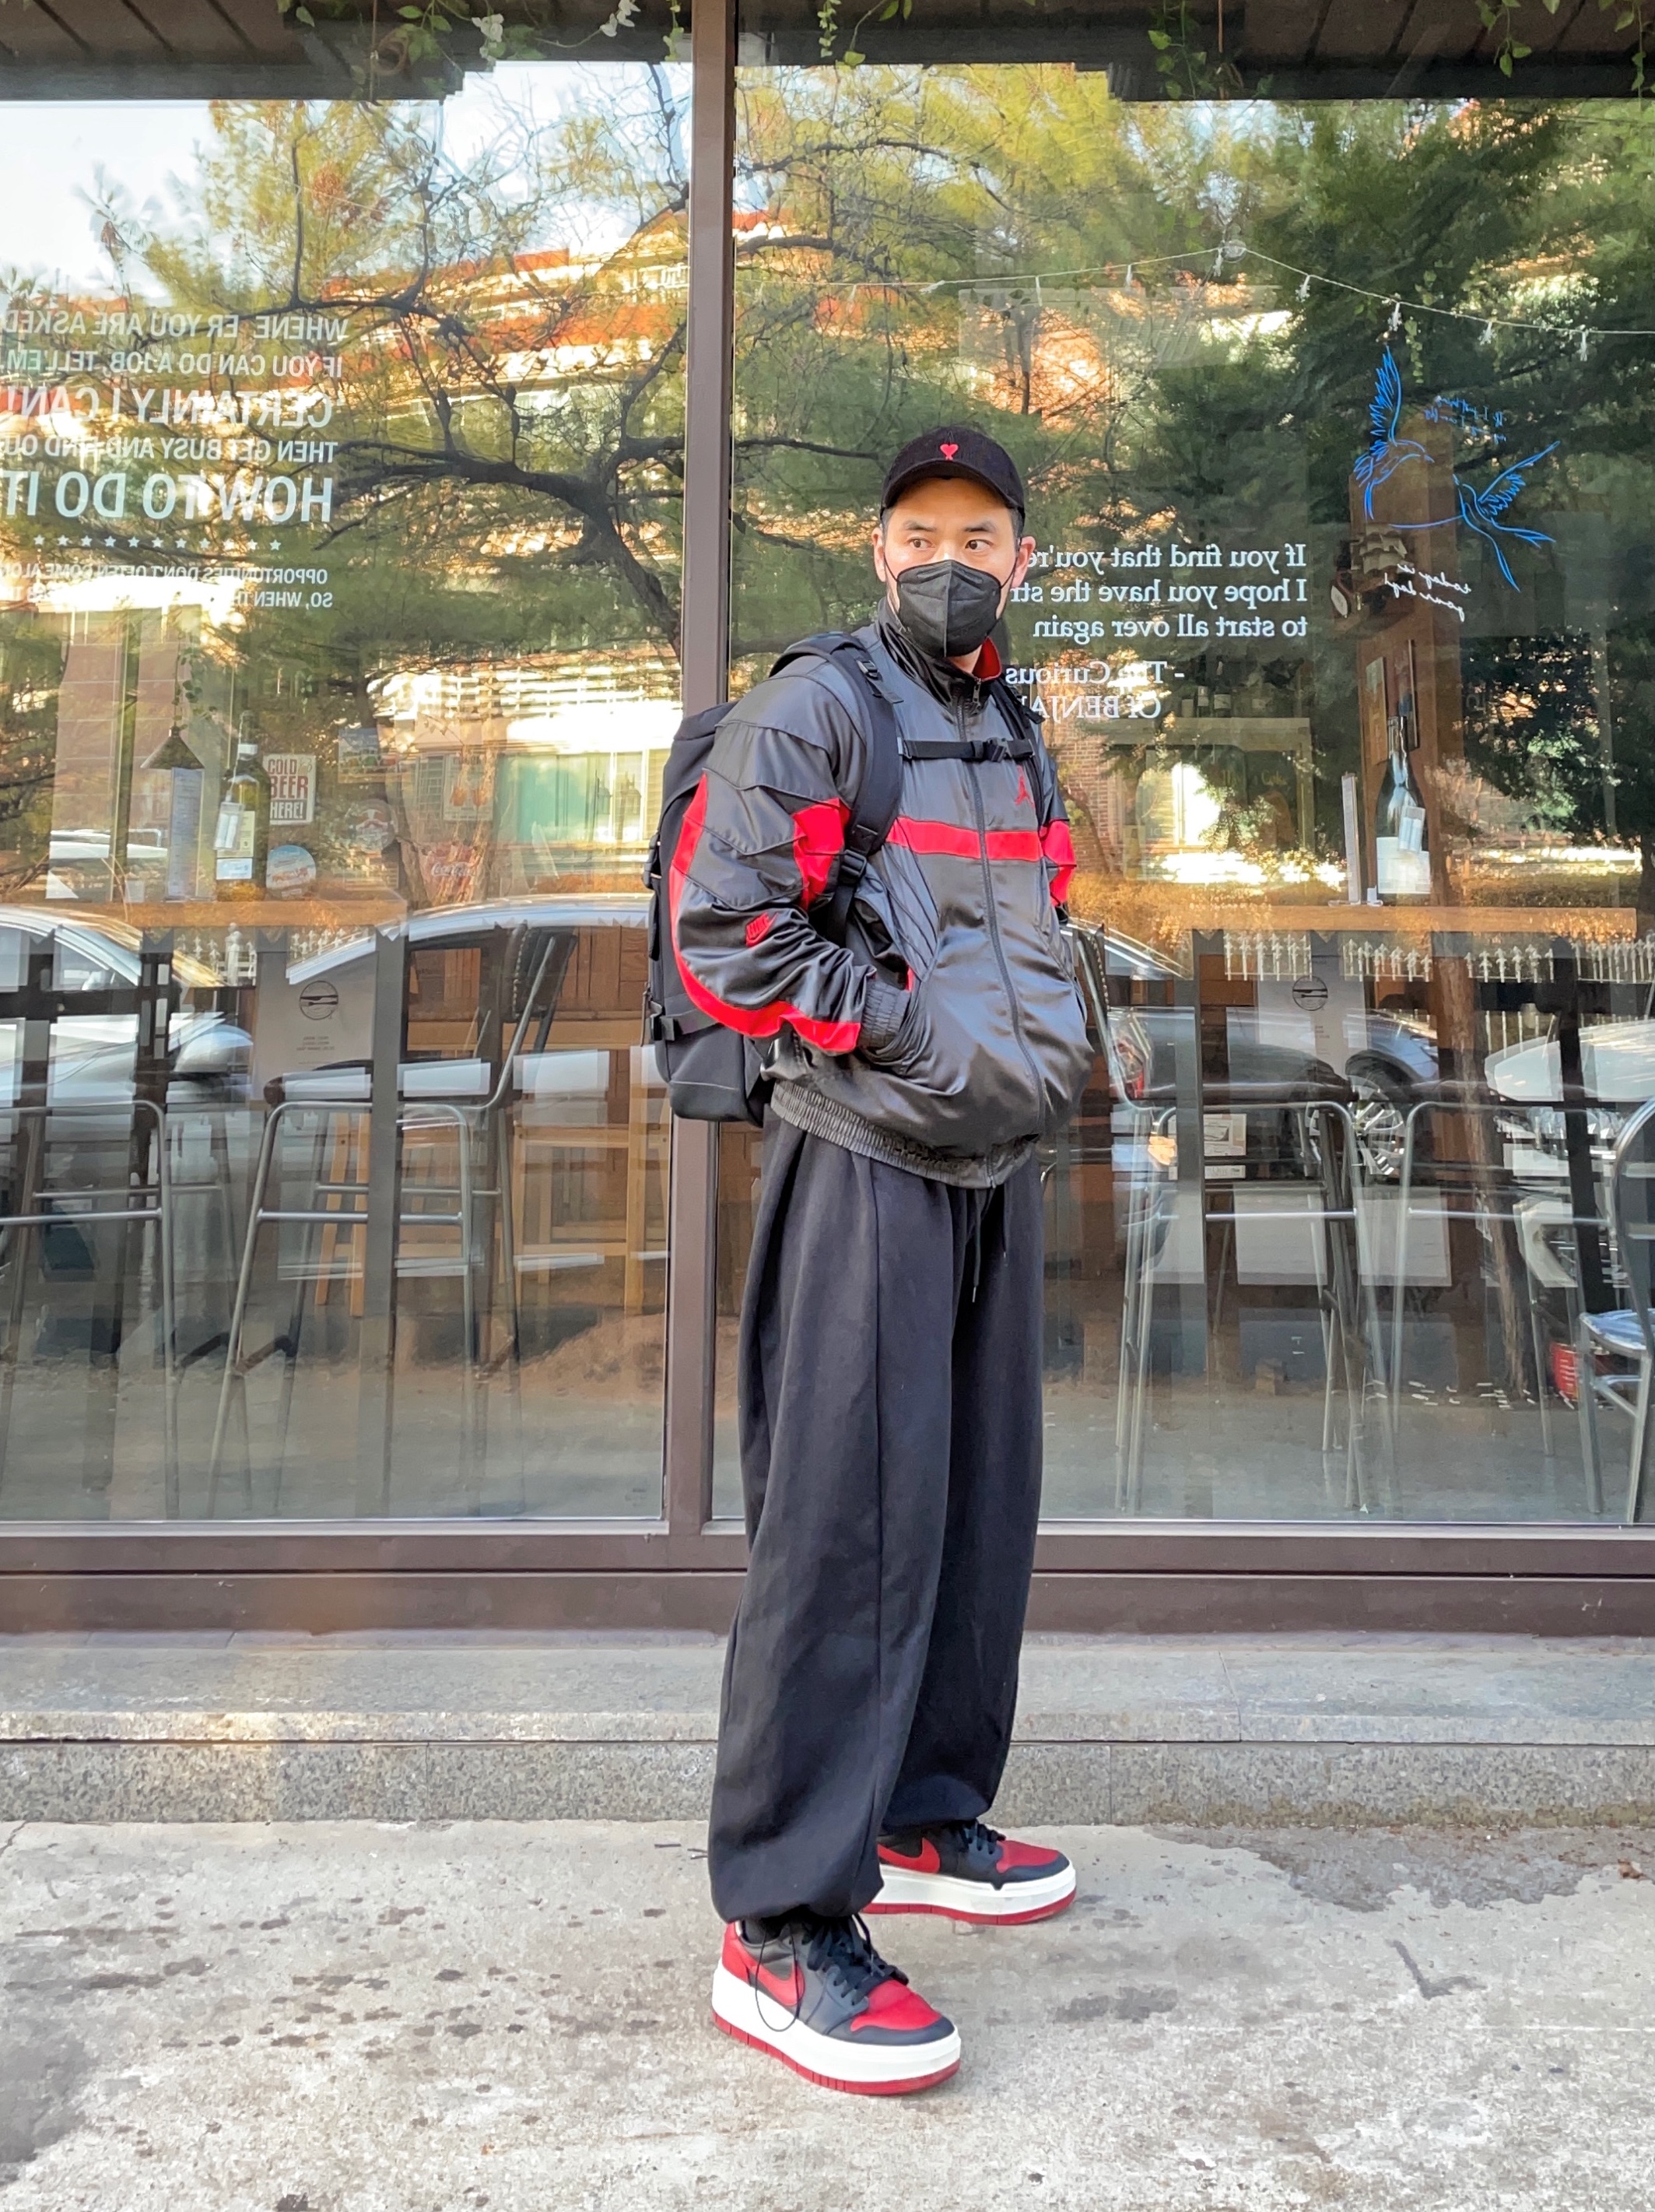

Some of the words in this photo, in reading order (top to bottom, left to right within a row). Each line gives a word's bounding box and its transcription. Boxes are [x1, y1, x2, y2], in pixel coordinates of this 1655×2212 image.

[268, 759, 297, 775] COLD
[270, 776, 308, 799] BEER
[270, 802, 303, 820] HERE!
